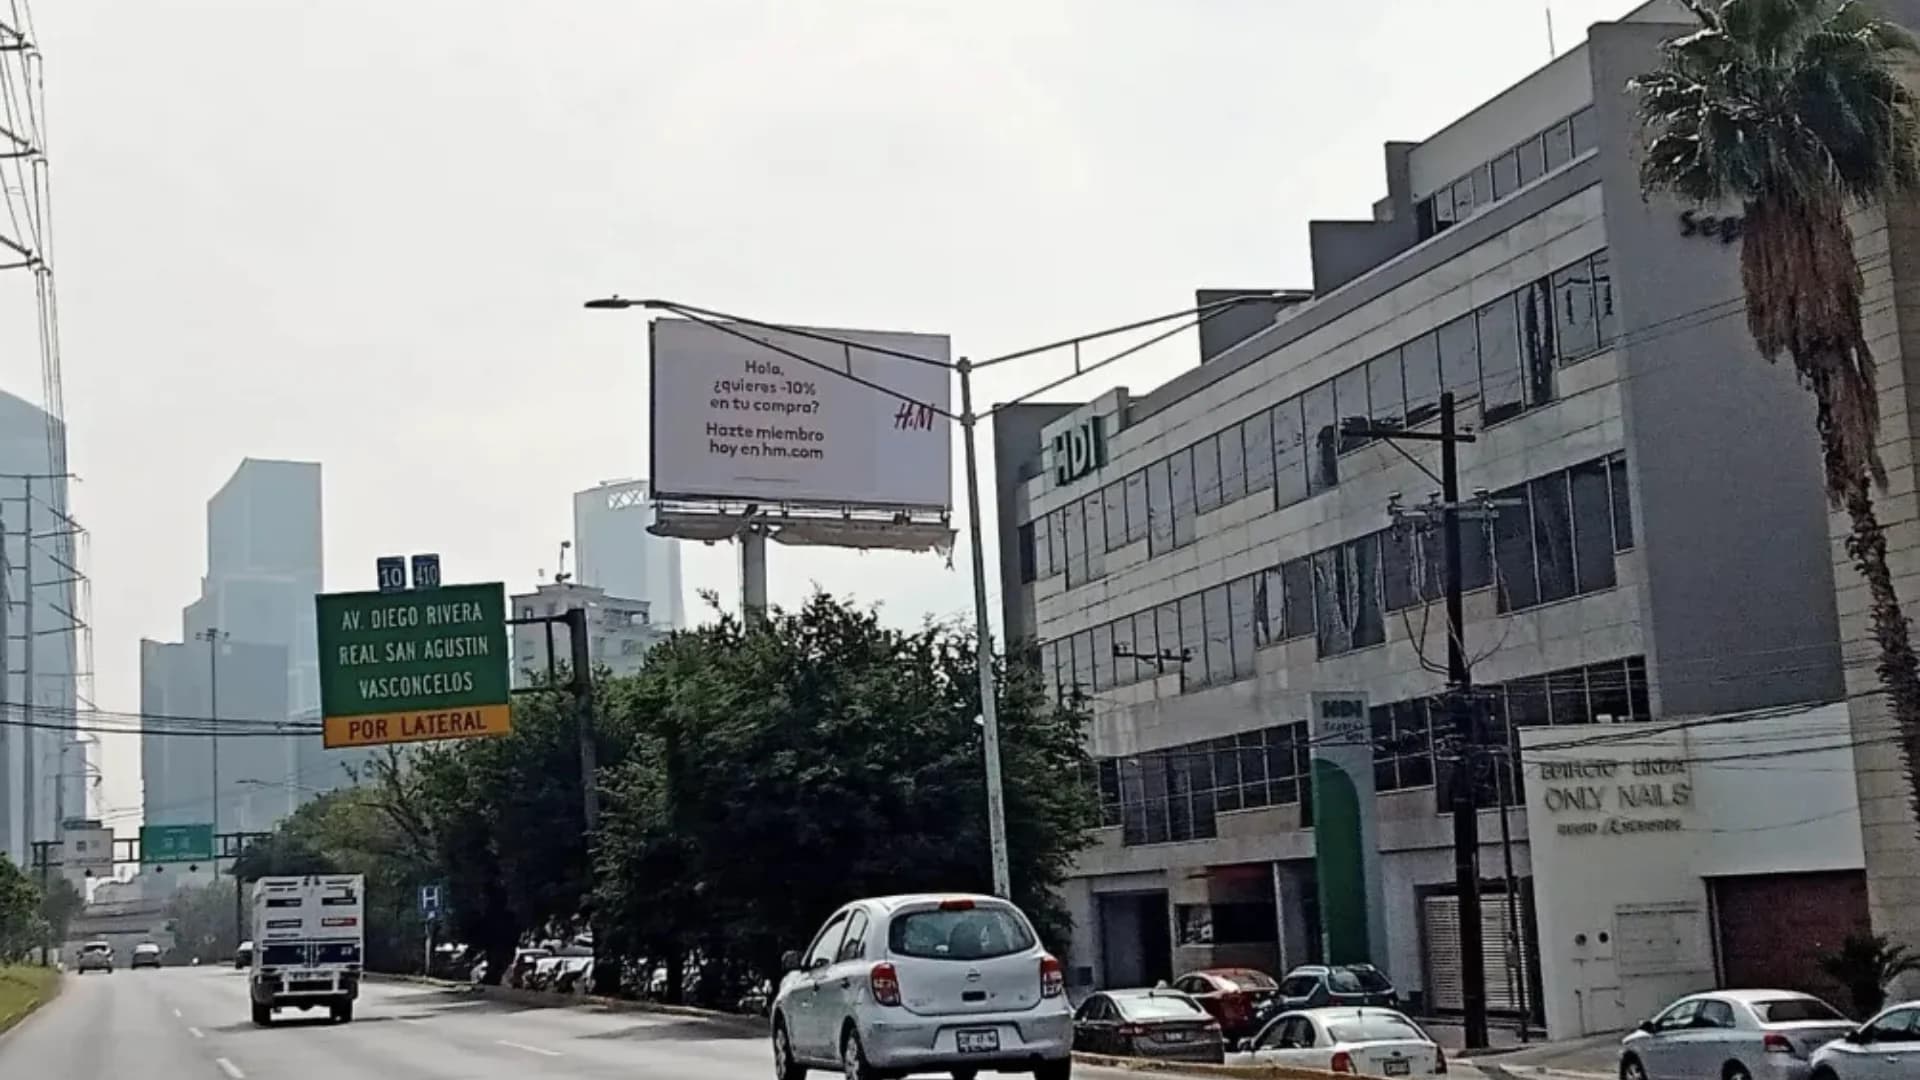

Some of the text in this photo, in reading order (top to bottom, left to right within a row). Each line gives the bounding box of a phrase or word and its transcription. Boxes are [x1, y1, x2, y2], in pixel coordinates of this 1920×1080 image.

[745, 360, 784, 376] Hola,
[713, 379, 816, 396] ¿quieres -10%
[710, 397, 819, 415] en tu compra?
[706, 421, 824, 442] Hazte miembro
[710, 439, 823, 459] hoy en hm.com
[1052, 417, 1107, 487] HDI
[381, 568, 401, 587] 10
[415, 564, 438, 585] 410
[342, 602, 483, 631] AV. DIEGO RIVERA
[339, 636, 489, 665] REAL SAN AGUSTIN
[359, 671, 473, 699] VASCONCELOS
[349, 710, 487, 740] POR LATERAL
[1545, 782, 1692, 811] ONLY NAILS
